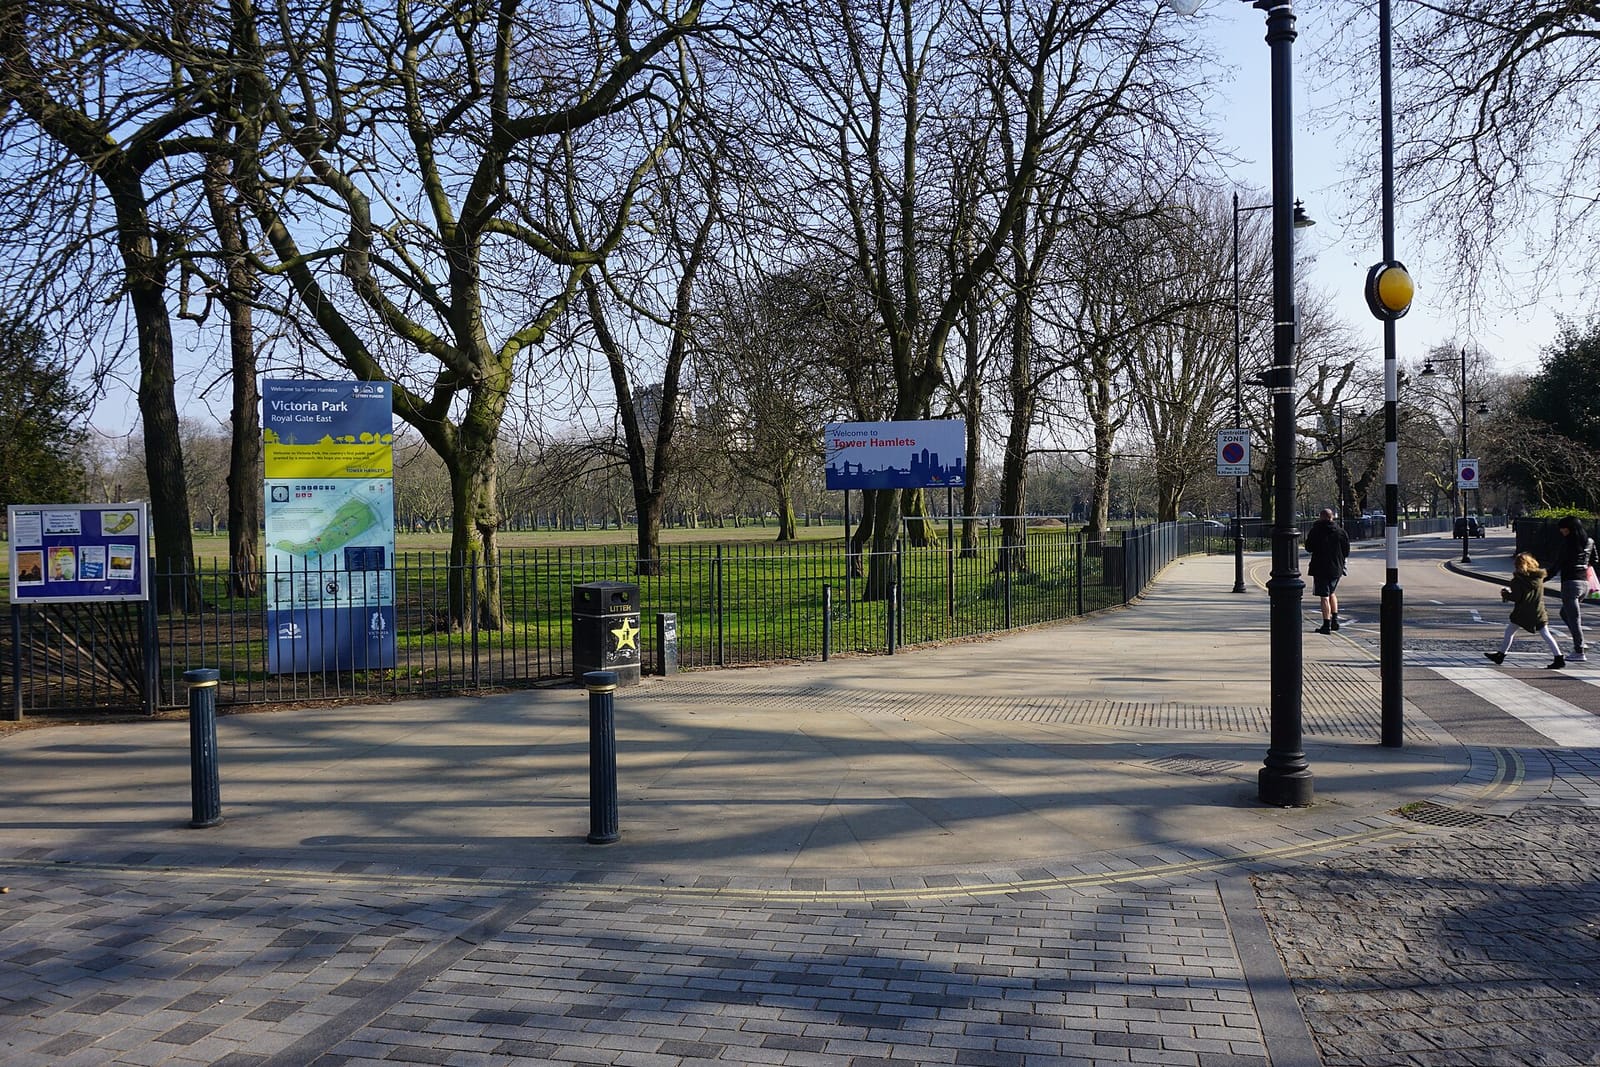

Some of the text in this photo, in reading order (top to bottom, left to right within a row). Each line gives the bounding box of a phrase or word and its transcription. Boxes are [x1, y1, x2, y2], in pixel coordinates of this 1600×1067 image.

[272, 400, 348, 412] Victoria Park
[272, 414, 292, 424] Royal
[295, 414, 314, 422] Gate
[833, 438, 916, 448] Tower Hamlets
